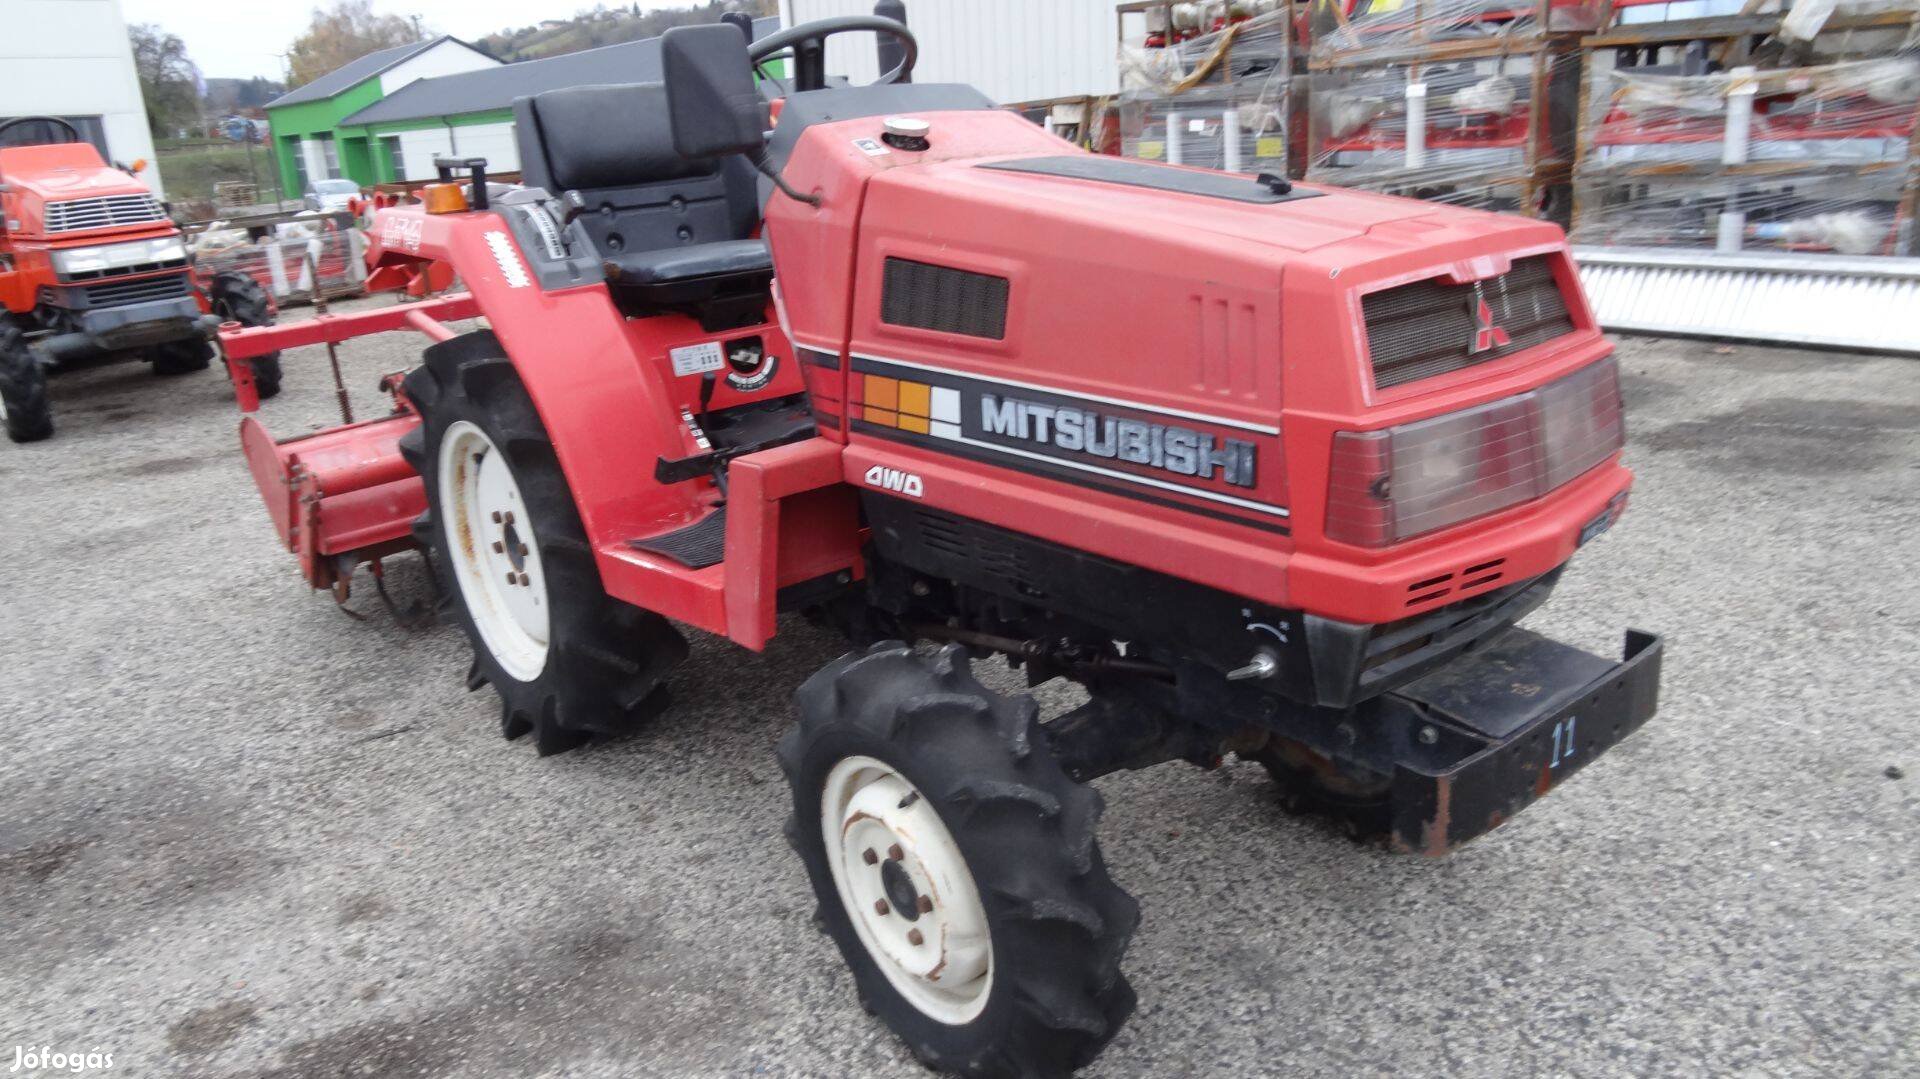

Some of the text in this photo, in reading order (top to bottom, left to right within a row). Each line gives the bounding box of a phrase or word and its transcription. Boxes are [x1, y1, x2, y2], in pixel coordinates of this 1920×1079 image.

[980, 394, 1256, 488] MITSUBISHI
[864, 465, 924, 498] 4WD
[1549, 716, 1576, 768] 11
